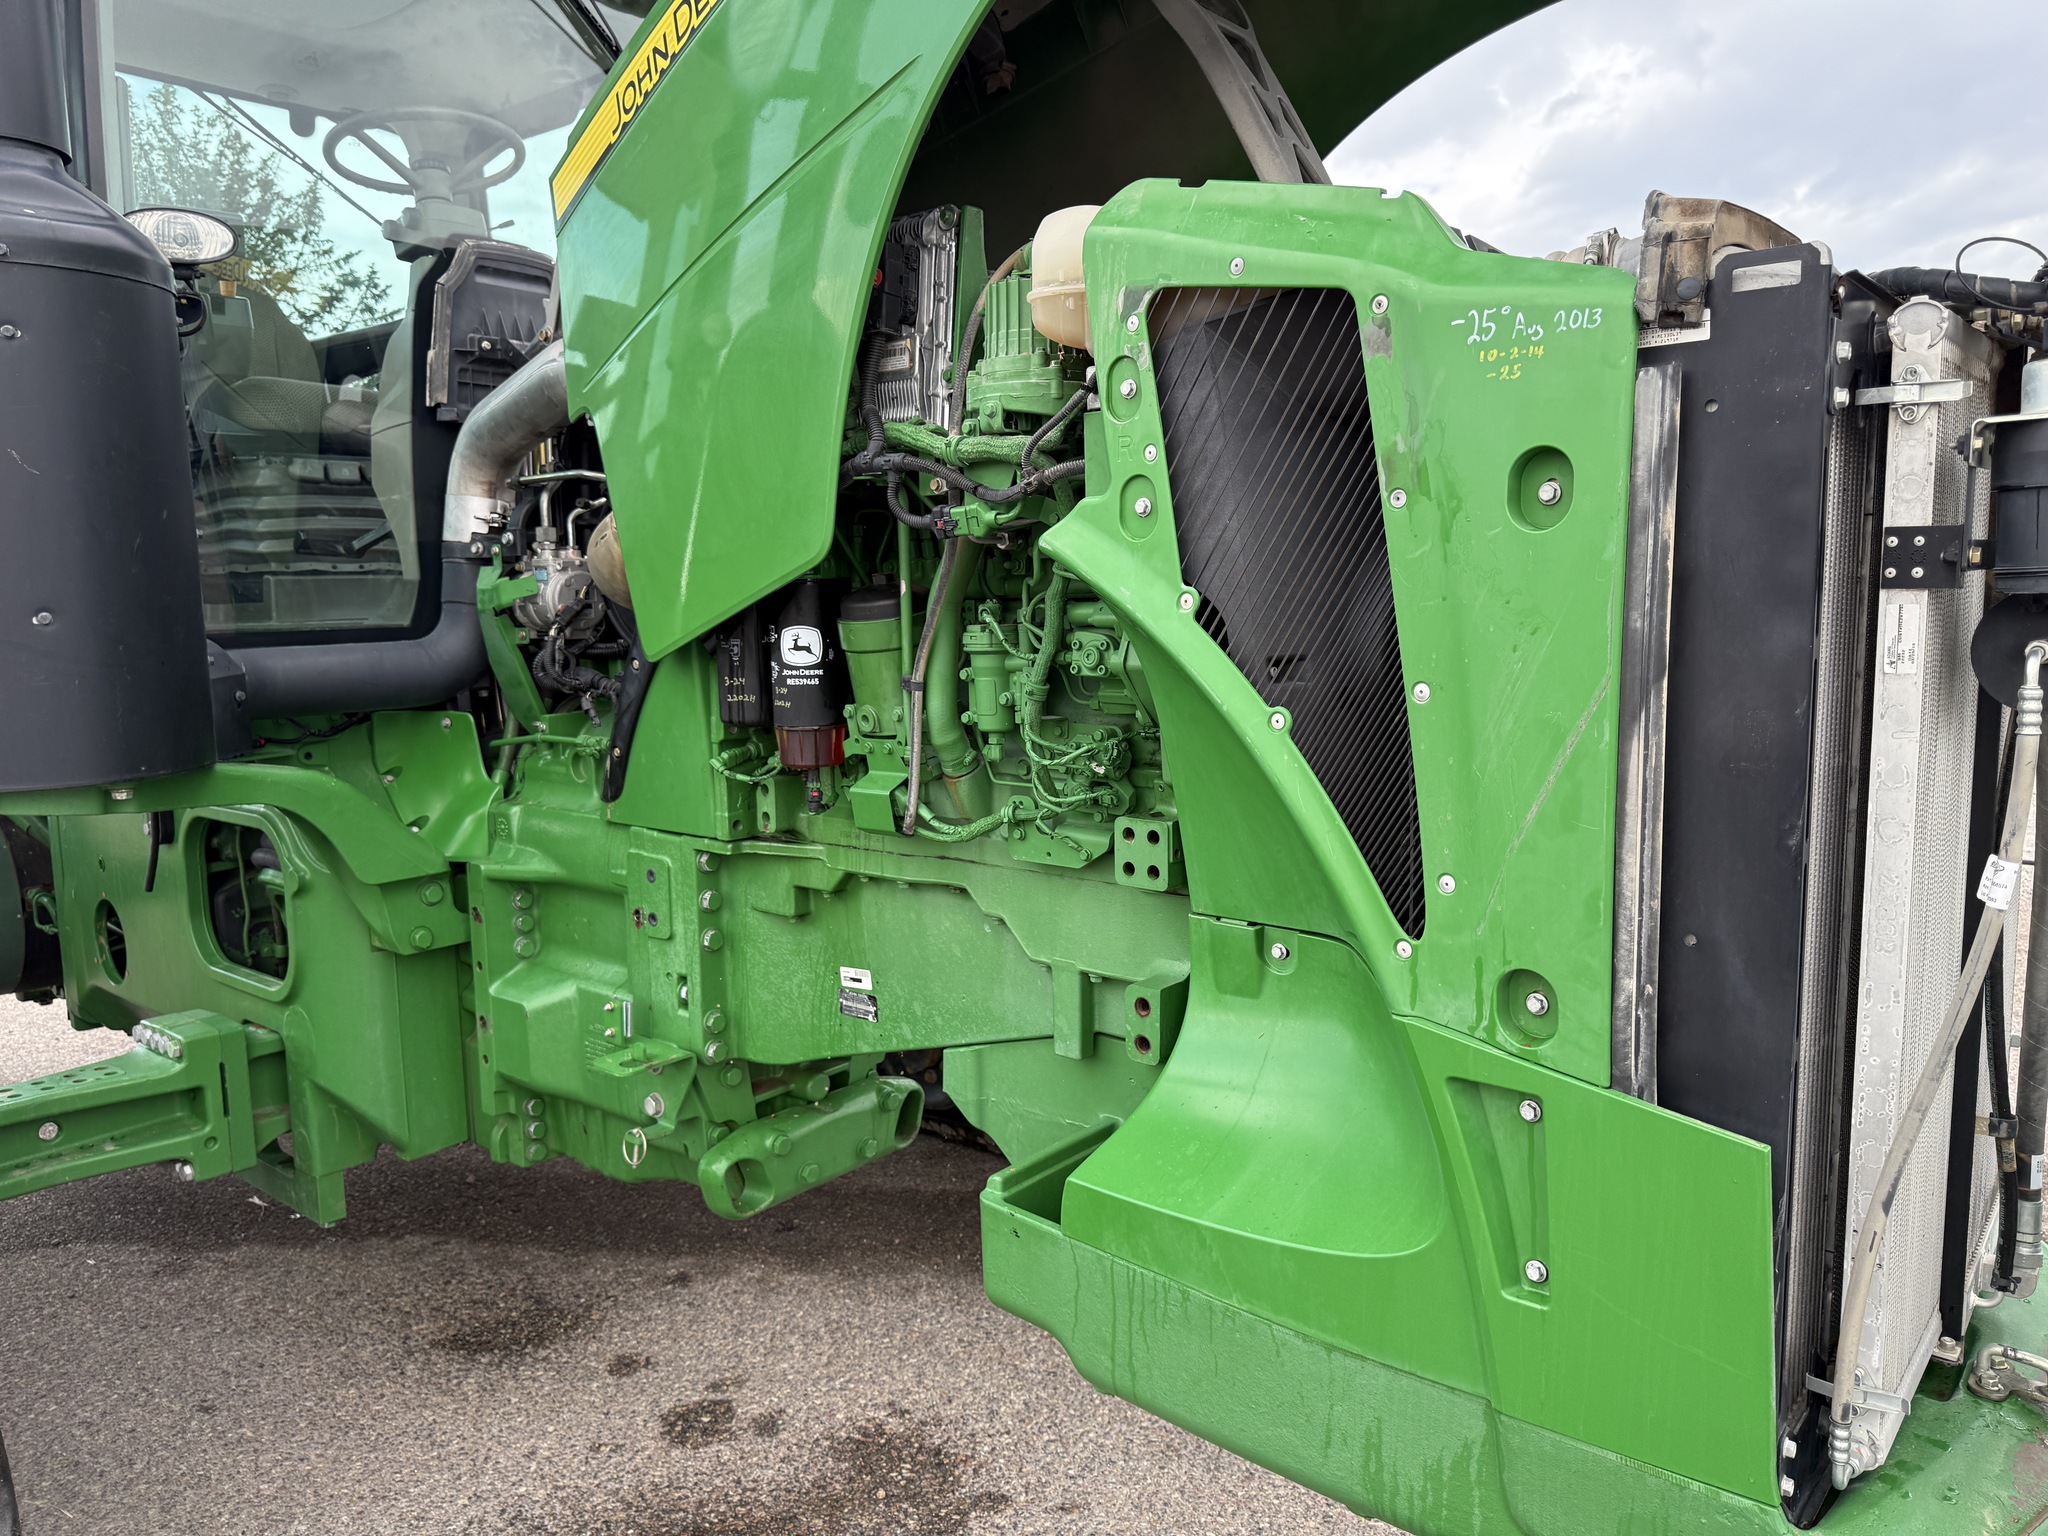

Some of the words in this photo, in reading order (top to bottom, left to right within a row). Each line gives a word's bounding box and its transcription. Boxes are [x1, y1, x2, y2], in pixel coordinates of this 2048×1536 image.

[611, 31, 672, 139] JOHN
[1511, 311, 1545, 342] Aug
[1553, 307, 1603, 333] 2013
[1478, 345, 1545, 363] 10-2-14
[1486, 363, 1523, 381] -25
